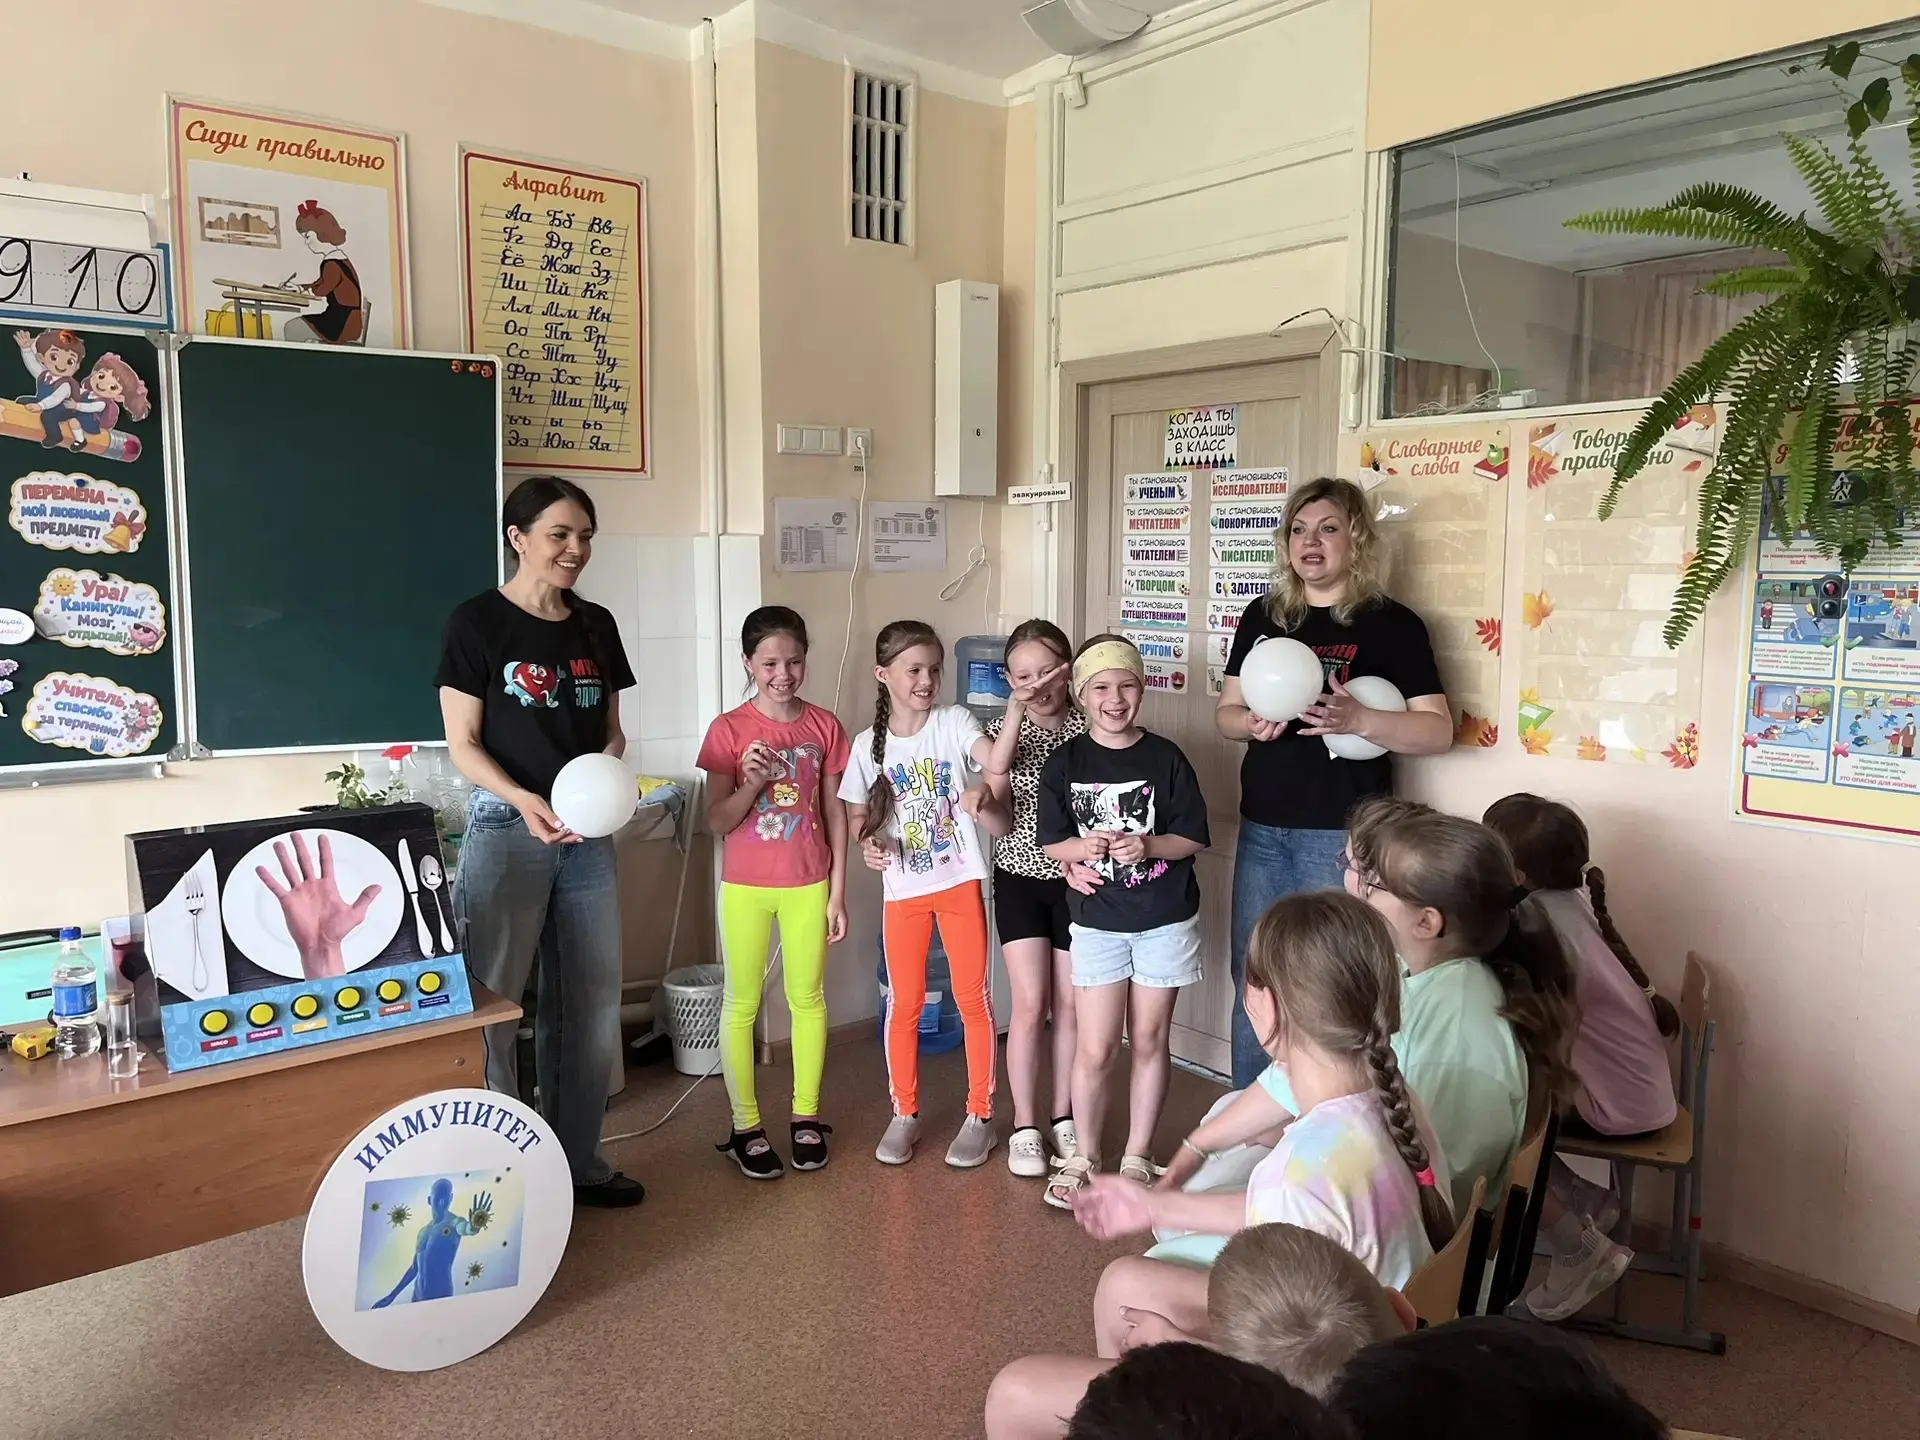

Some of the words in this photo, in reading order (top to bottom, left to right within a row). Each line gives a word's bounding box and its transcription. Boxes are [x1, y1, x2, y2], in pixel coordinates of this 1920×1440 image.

[185, 120, 248, 154] Сиди
[256, 138, 386, 171] правильно
[502, 170, 608, 204] Алфавит
[505, 203, 533, 224] Аа
[546, 209, 575, 229] Бб
[588, 216, 614, 235] Вв
[503, 225, 525, 245] Гг
[544, 231, 575, 260] Дд
[589, 239, 613, 257] Ее
[0, 239, 31, 303] 9
[500, 245, 525, 267] Ёё
[539, 254, 582, 275] Жж
[590, 260, 612, 286] Зз
[500, 272, 529, 292] Ии
[544, 274, 571, 296] Йй
[580, 281, 609, 301] Кк
[501, 295, 533, 315] Лл
[541, 301, 580, 320] Мм
[586, 305, 612, 323] Нн
[504, 319, 528, 336] Оо
[544, 322, 572, 341] Пп
[583, 325, 608, 351] Рр
[506, 342, 530, 359] Сс
[542, 343, 577, 363] Тт
[595, 348, 619, 373] Уу
[506, 362, 541, 389] Фф
[550, 367, 582, 386] Хх
[594, 371, 623, 393] Цц
[509, 386, 536, 405] Чч
[551, 389, 584, 409] Шш
[592, 392, 628, 415] Щщ
[1168, 411, 1213, 426] КОГДА
[1216, 408, 1235, 422] ТЫ
[507, 429, 529, 447] Ээ
[542, 432, 575, 450] Юю
[588, 435, 612, 452] Яя
[1167, 424, 1236, 441] ЗАХОДИШЬ
[1175, 442, 1183, 454] В
[1187, 439, 1226, 453] КЛАСС
[1389, 438, 1482, 461] Словарные
[1411, 456, 1460, 476] слова
[1561, 448, 1674, 476] правино
[1128, 477, 1139, 485] ТЫ
[1139, 475, 1188, 485] СТАНОВИШЬСЯ
[1216, 474, 1227, 482] ТЫ
[1229, 472, 1282, 482] СТАНОВИШЬСЯ
[21, 484, 105, 505] ПЕРЕМЕНА
[1012, 489, 1067, 499] эвакуированы
[1139, 486, 1176, 499] УЧЕНЫМ
[1212, 482, 1287, 497] ИССЛЕДОВАТЕЛЕМ
[21, 504, 47, 517] МОЙ
[50, 506, 111, 522] ЛЮБИМЫЙ
[1126, 508, 1136, 516] ТЫ
[1137, 507, 1184, 516] СТАНОВИШЬСЯ
[1228, 506, 1282, 515] СТАНОВИШЬСЯ
[30, 521, 100, 540] ПРЕДМЕТ!
[1129, 518, 1181, 530] МЕЧТАТЕЛЕМ
[1218, 516, 1278, 529] ПОКОРИТЕЛЕМ
[1127, 539, 1137, 547] ТЫ
[1138, 538, 1186, 547] СТАНОВИШЬСЯ
[1228, 537, 1275, 547] СТАНОВИШЬС
[1130, 549, 1176, 561] ЧИТАТЕЛЕМ
[1221, 550, 1274, 562] ПИСАТЕЛЕМ
[1138, 569, 1185, 577] СТАНОВИШЬСЯ
[1215, 571, 1226, 580] ТЫ
[81, 579, 130, 601] Ура!
[1135, 579, 1176, 594] ТВОРЦОМ
[60, 598, 146, 619] Каникулы!
[1125, 601, 1135, 609] ТЫ
[1136, 600, 1183, 610] СТАНОВИШЬСЯ
[1212, 604, 1223, 612] ТЫ
[77, 614, 116, 630] Мозг,
[1121, 610, 1186, 622] ПУТЕШЕСТВЕННИКОМ
[68, 629, 129, 643] отдыхай!
[1126, 633, 1136, 641] ТЫ
[1137, 634, 1184, 643] СТАНОВИШЬСЯ
[1139, 643, 1172, 658] ДРУГОМ
[1146, 665, 1162, 673] ТЕБЯ
[1144, 675, 1169, 688] ЮБЯТ
[52, 679, 127, 710] Учитель,
[54, 700, 113, 720] спасибо
[39, 714, 55, 725] за
[58, 716, 125, 738] терпение!
[354, 1101, 542, 1173] ИММУНИТЕТ
